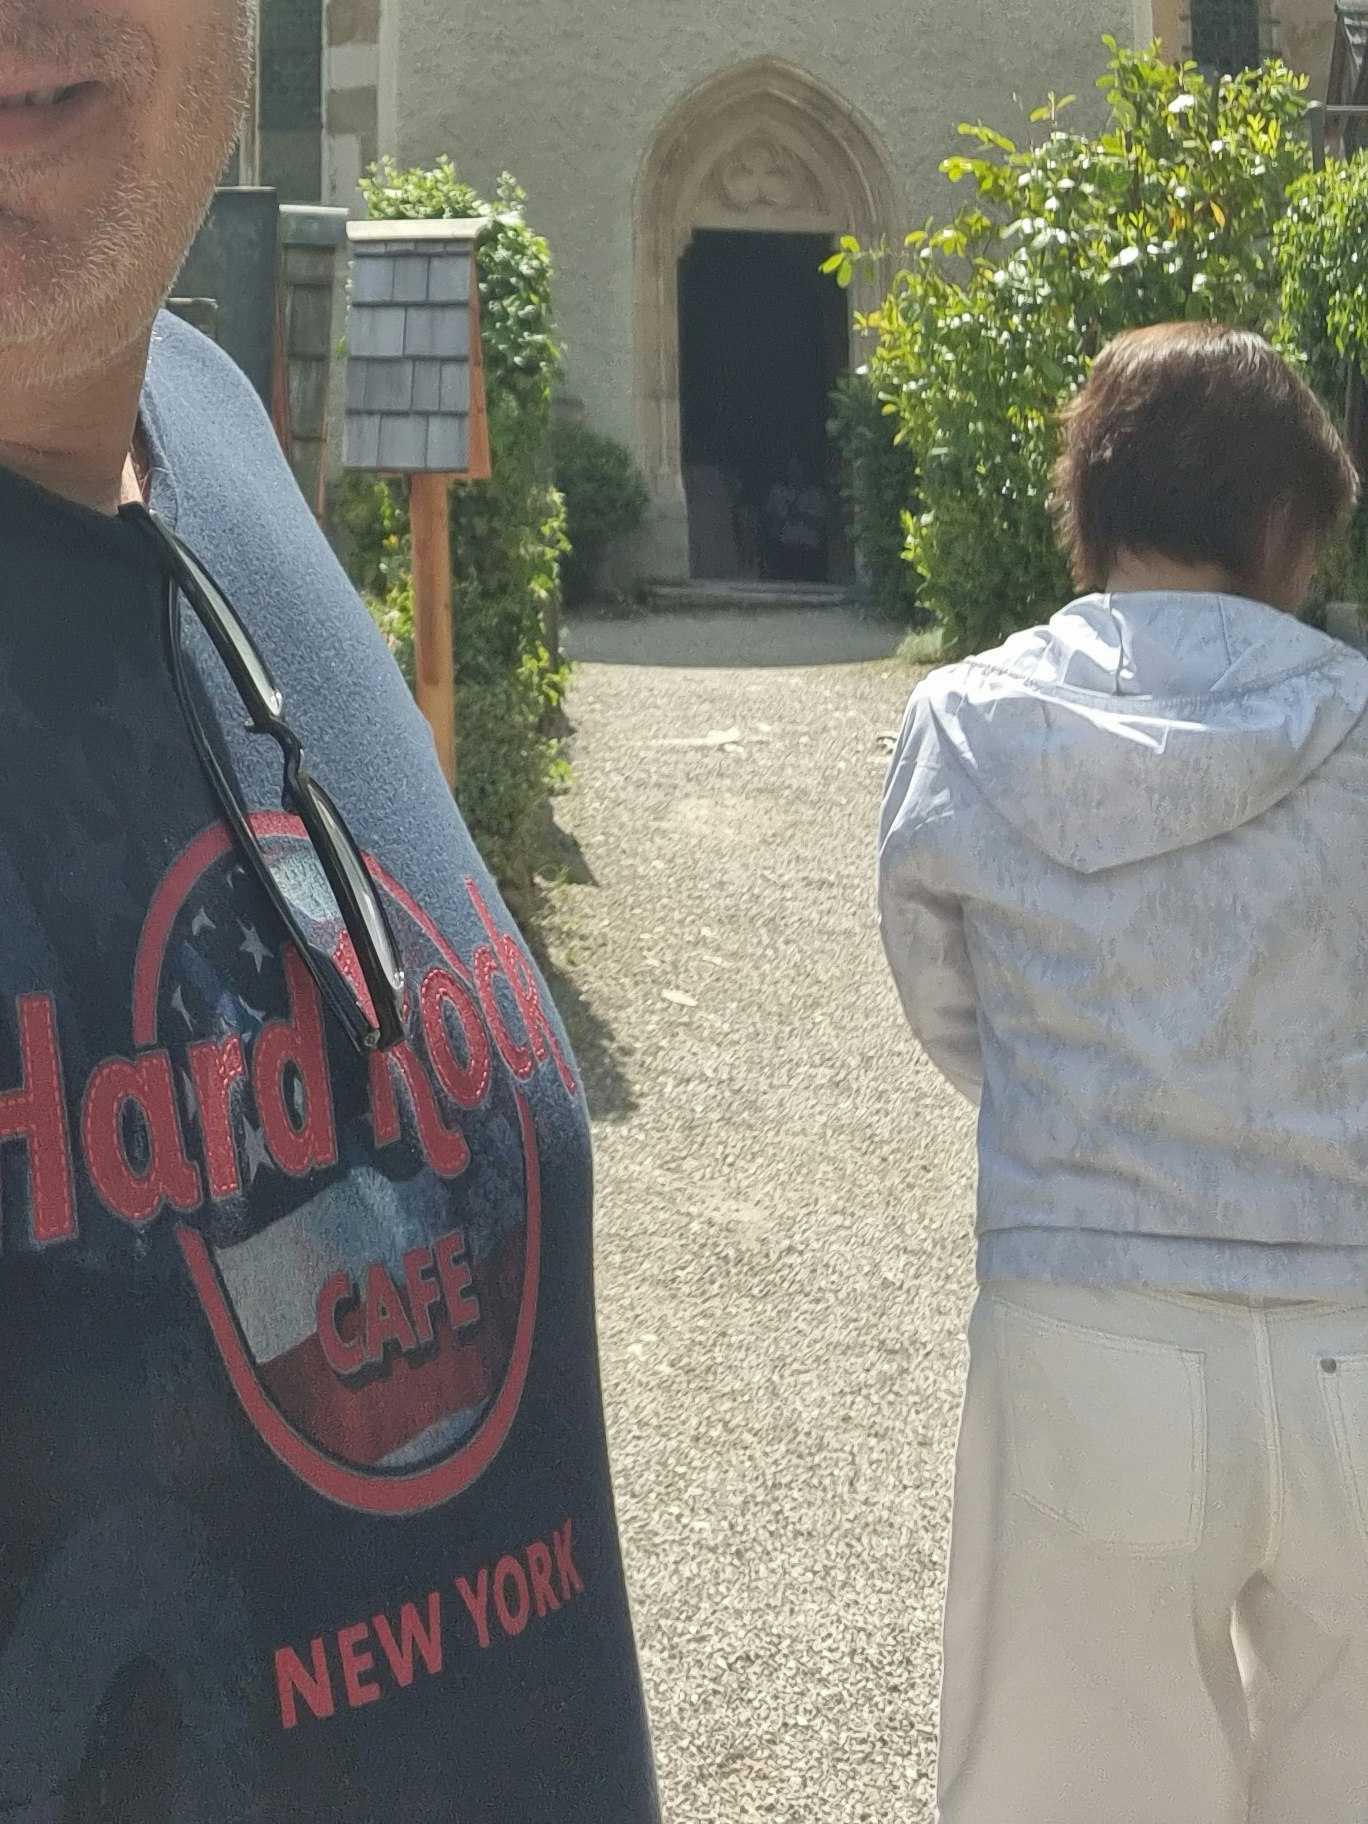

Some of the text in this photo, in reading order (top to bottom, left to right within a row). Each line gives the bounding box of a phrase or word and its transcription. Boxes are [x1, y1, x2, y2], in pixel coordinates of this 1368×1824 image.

[334, 876, 576, 1177] Rock
[316, 1231, 480, 1376] CAFE
[275, 1591, 443, 1728] NEW
[455, 1518, 583, 1649] YORK
